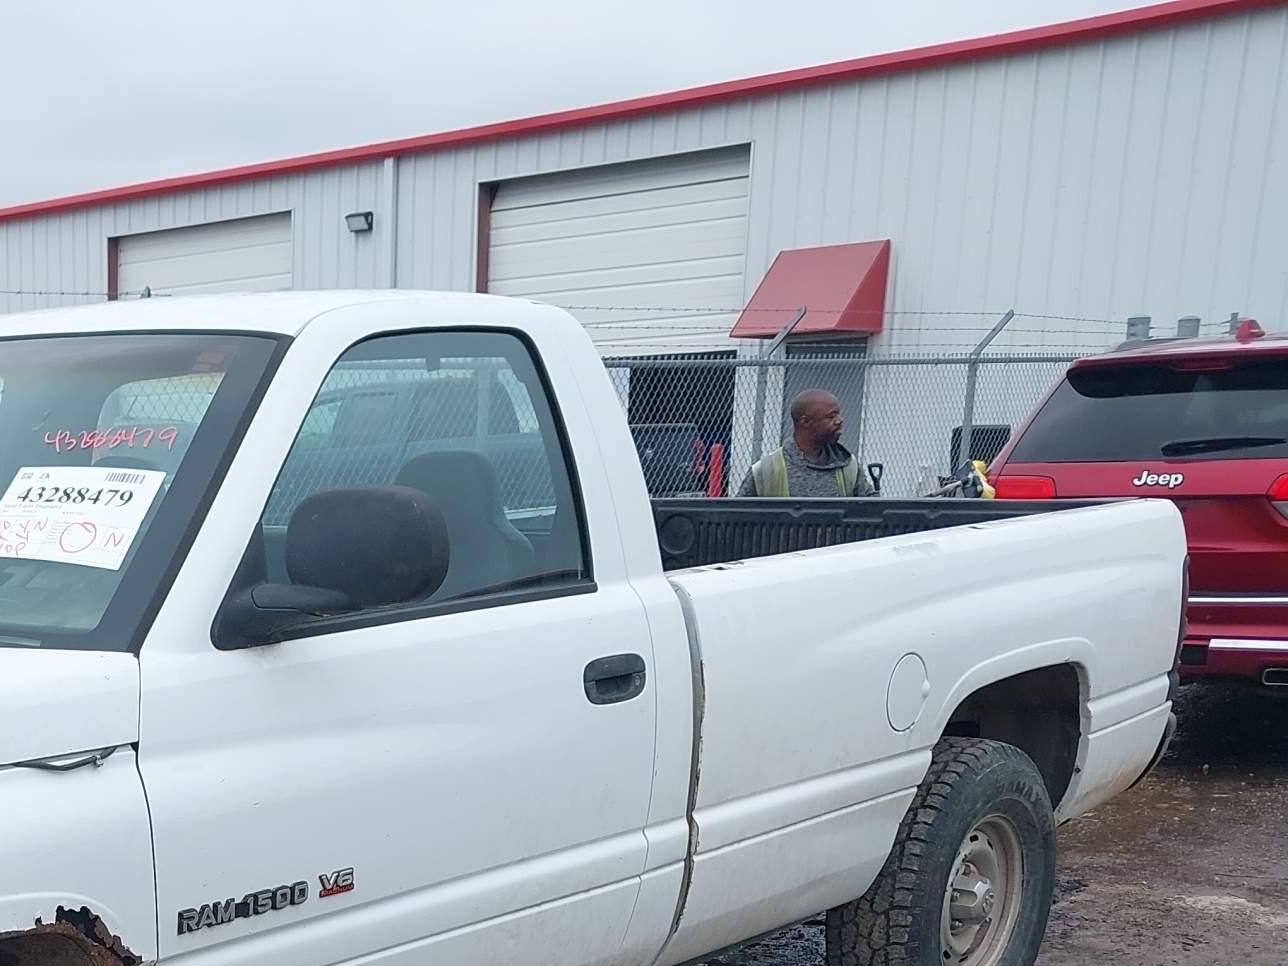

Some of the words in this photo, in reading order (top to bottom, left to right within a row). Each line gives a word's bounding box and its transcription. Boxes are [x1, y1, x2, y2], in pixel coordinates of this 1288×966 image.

[1133, 470, 1184, 488] Jeep
[16, 485, 134, 508] 43288479
[177, 898, 236, 936] RAM
[240, 881, 309, 918] 1500
[319, 867, 354, 890] V6
